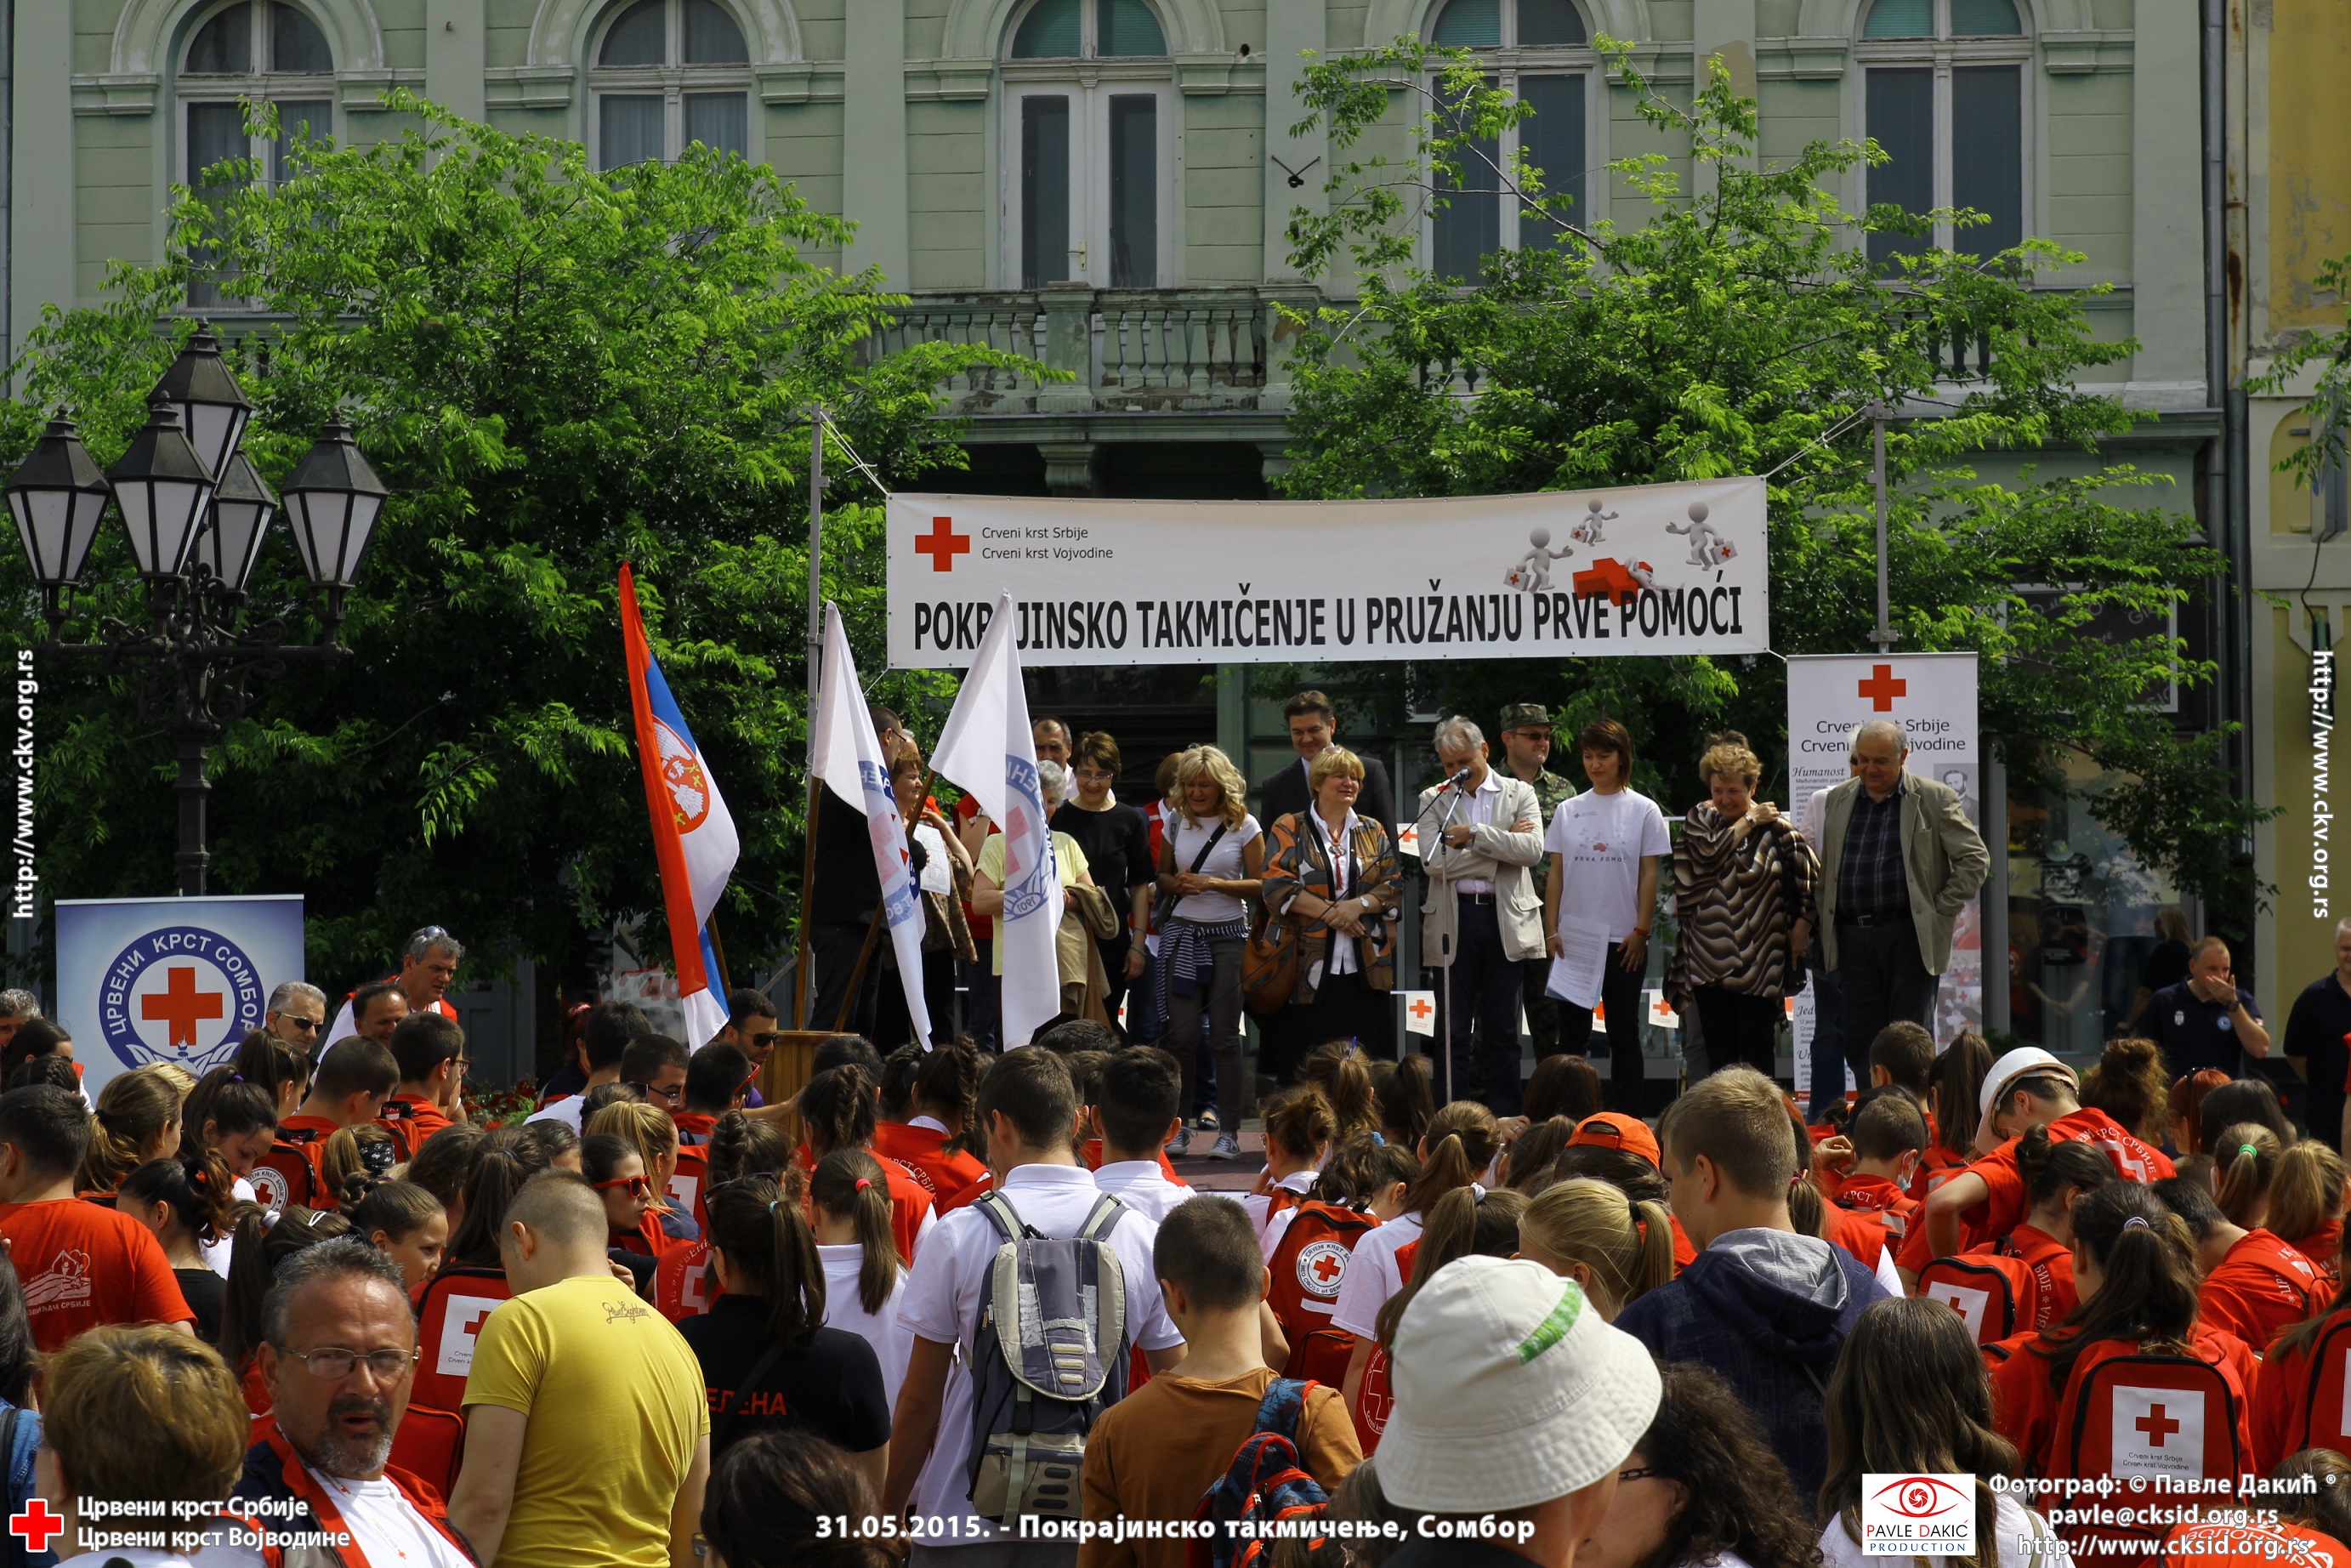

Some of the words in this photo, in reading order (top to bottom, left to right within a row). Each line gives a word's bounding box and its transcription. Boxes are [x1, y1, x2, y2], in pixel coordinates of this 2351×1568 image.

[982, 526, 1021, 539] Crveni
[1025, 526, 1049, 539] krst
[1053, 526, 1088, 542] Srbije
[982, 547, 1021, 560] Crveni
[1025, 547, 1049, 560] krst
[1053, 547, 1114, 561] Vojvodine
[915, 599, 1127, 650] POKRJINSKO
[1137, 582, 1326, 649] TAKMIČENJE
[1337, 598, 1355, 645] U
[1366, 579, 1522, 645] PRUŽANJU
[1534, 590, 1610, 640] PRVE
[1621, 570, 1743, 639] POMOĆI
[1905, 719, 1950, 734] Srbije
[1905, 737, 1966, 753] jvodine
[1792, 766, 1844, 777] Humanost
[106, 949, 145, 1036] ЦРВЕНИ
[152, 934, 212, 953] КРСТ
[2122, 1136, 2156, 1173] СРБИЈЕ
[1305, 1245, 1324, 1257] CRVENI
[1326, 1244, 1343, 1253] KRST
[1303, 1278, 1320, 1292] CROSS
[2034, 1264, 2052, 1292] БИЈЕ
[61, 1300, 91, 1309] СРБИЈЕ
